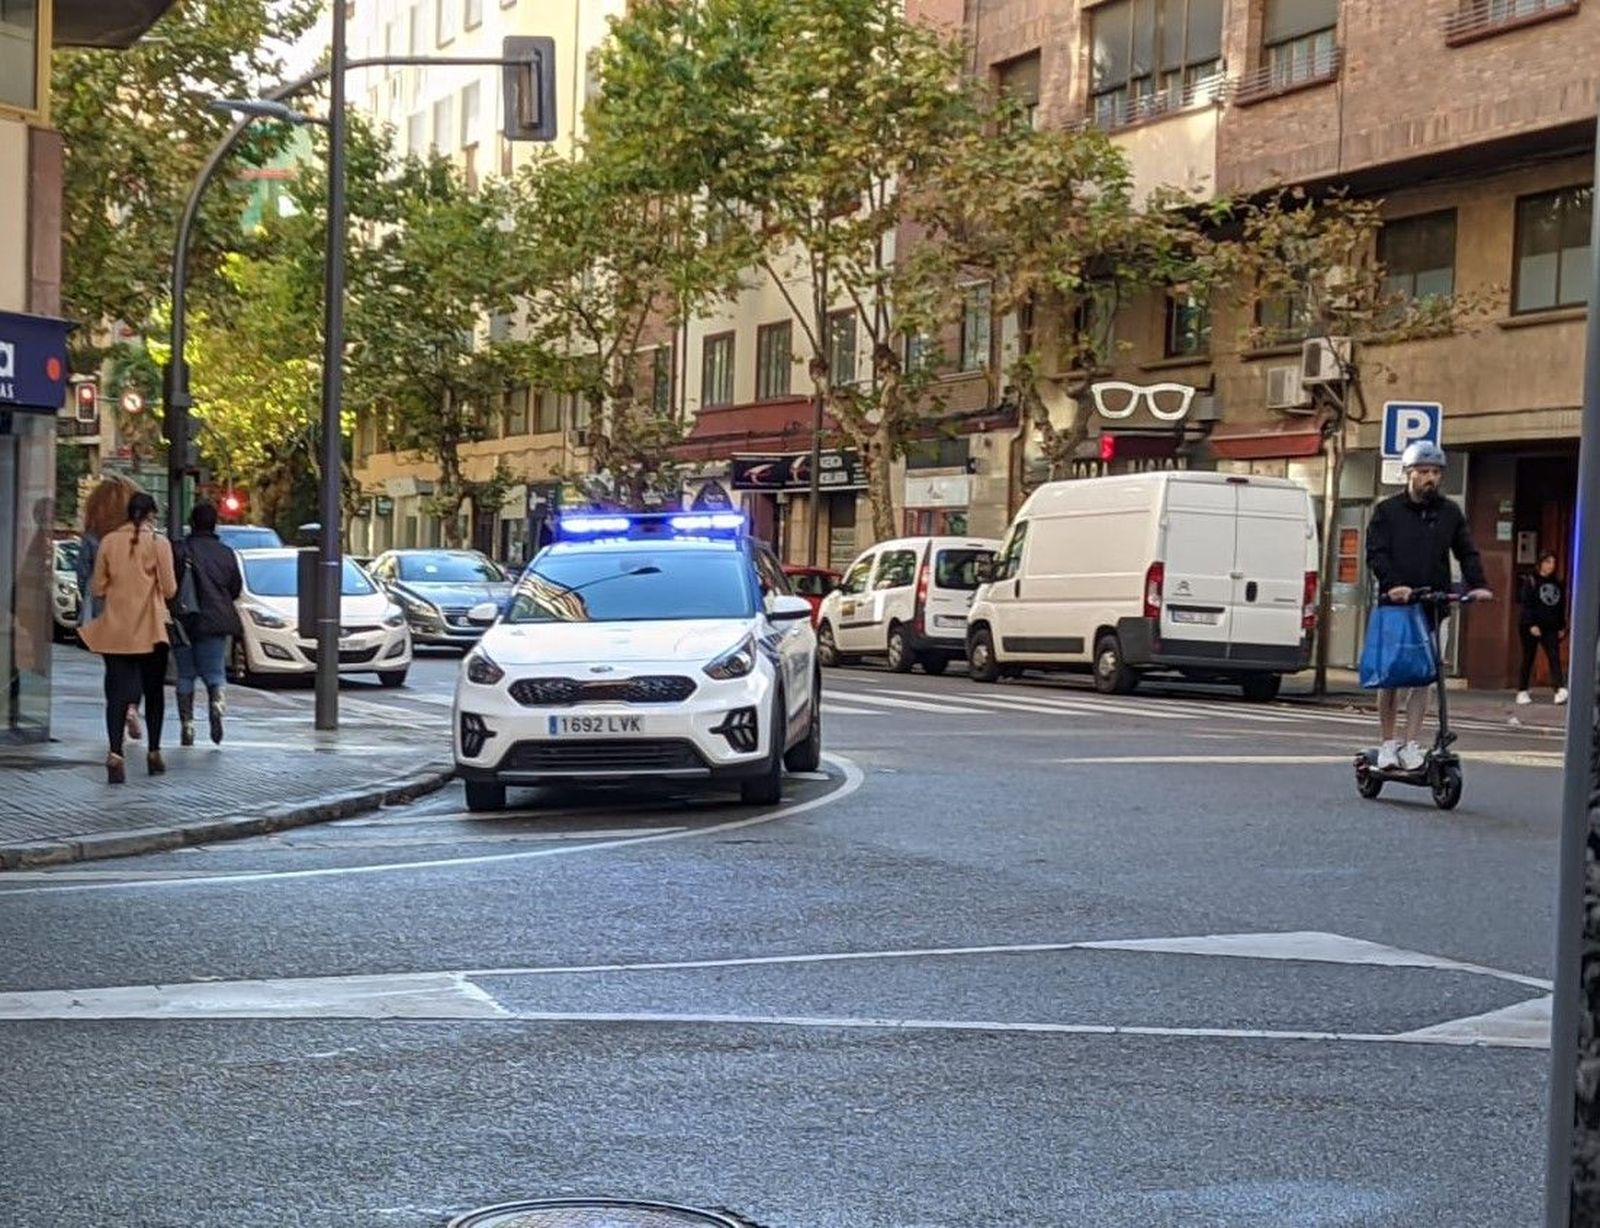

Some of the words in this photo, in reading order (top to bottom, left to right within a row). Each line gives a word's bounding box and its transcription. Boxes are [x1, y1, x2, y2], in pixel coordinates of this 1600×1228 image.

[1395, 409, 1431, 452] P
[561, 716, 603, 733] 1692
[607, 716, 641, 733] LVK
